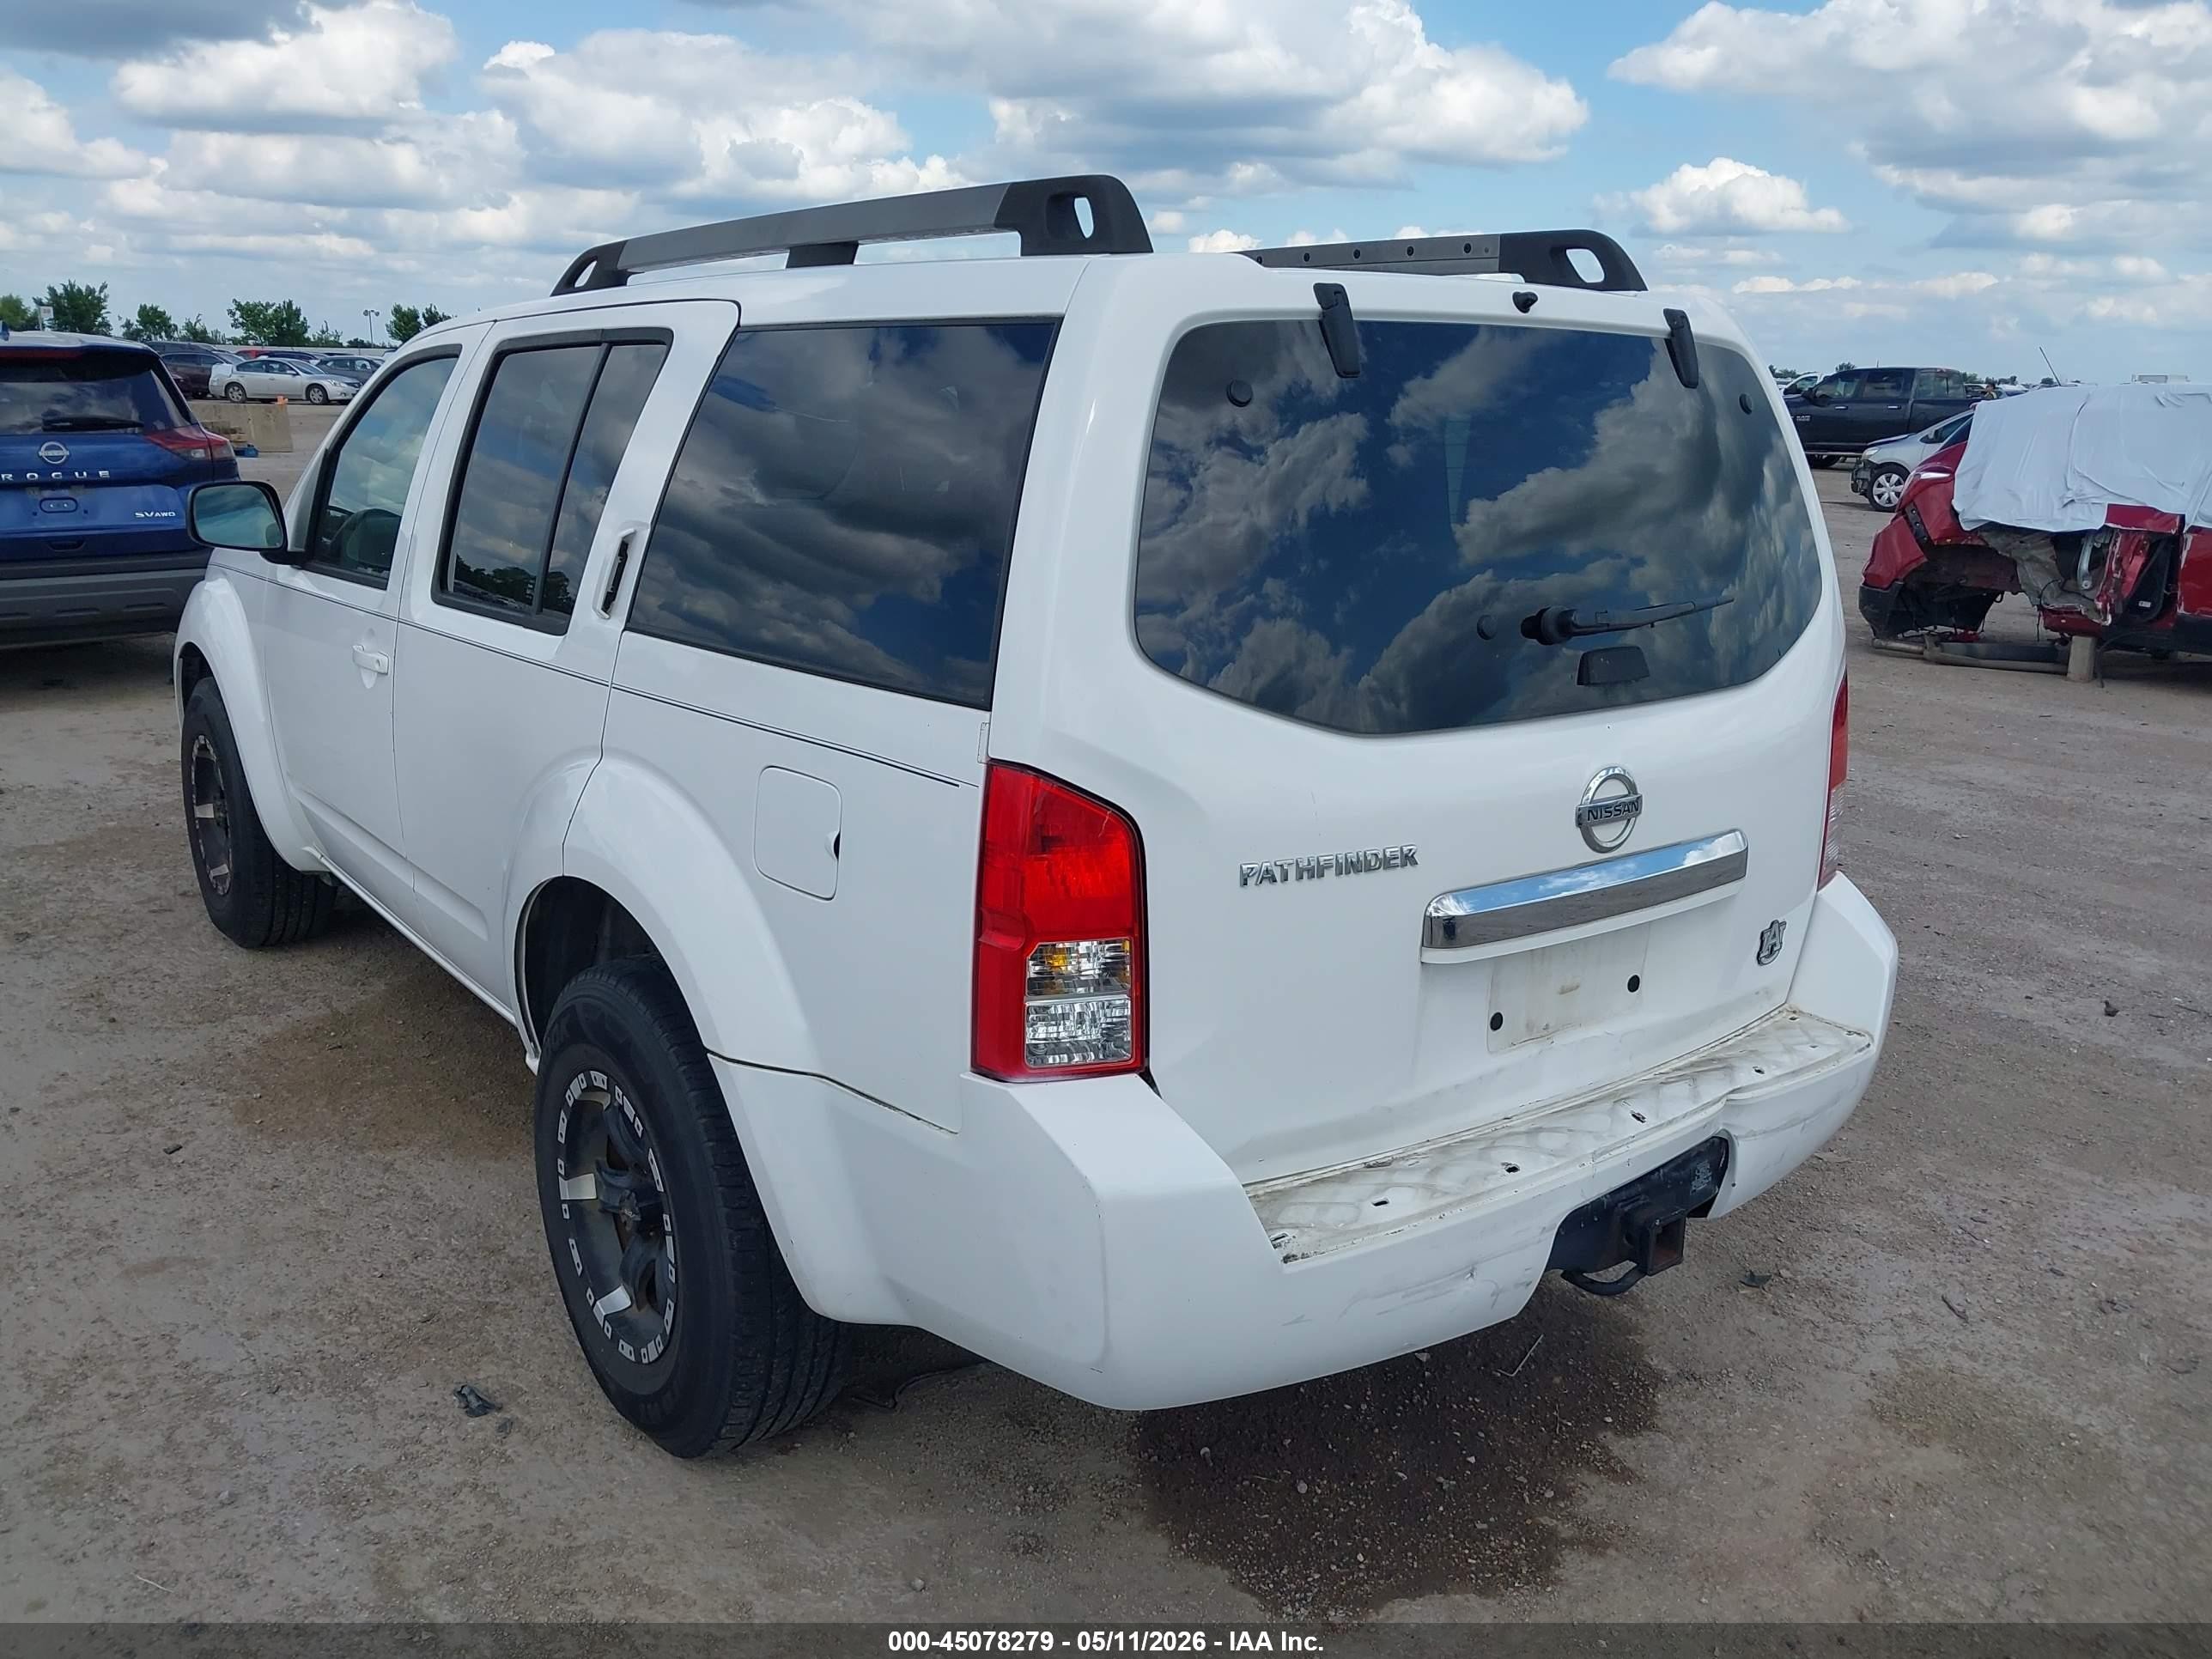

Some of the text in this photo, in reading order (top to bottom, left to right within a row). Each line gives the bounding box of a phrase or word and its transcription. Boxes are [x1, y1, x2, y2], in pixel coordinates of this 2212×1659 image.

[1, 471, 110, 481] ROGUE
[1587, 799, 1639, 821] NISSAN
[1240, 844, 1419, 887] PATHFINDER
